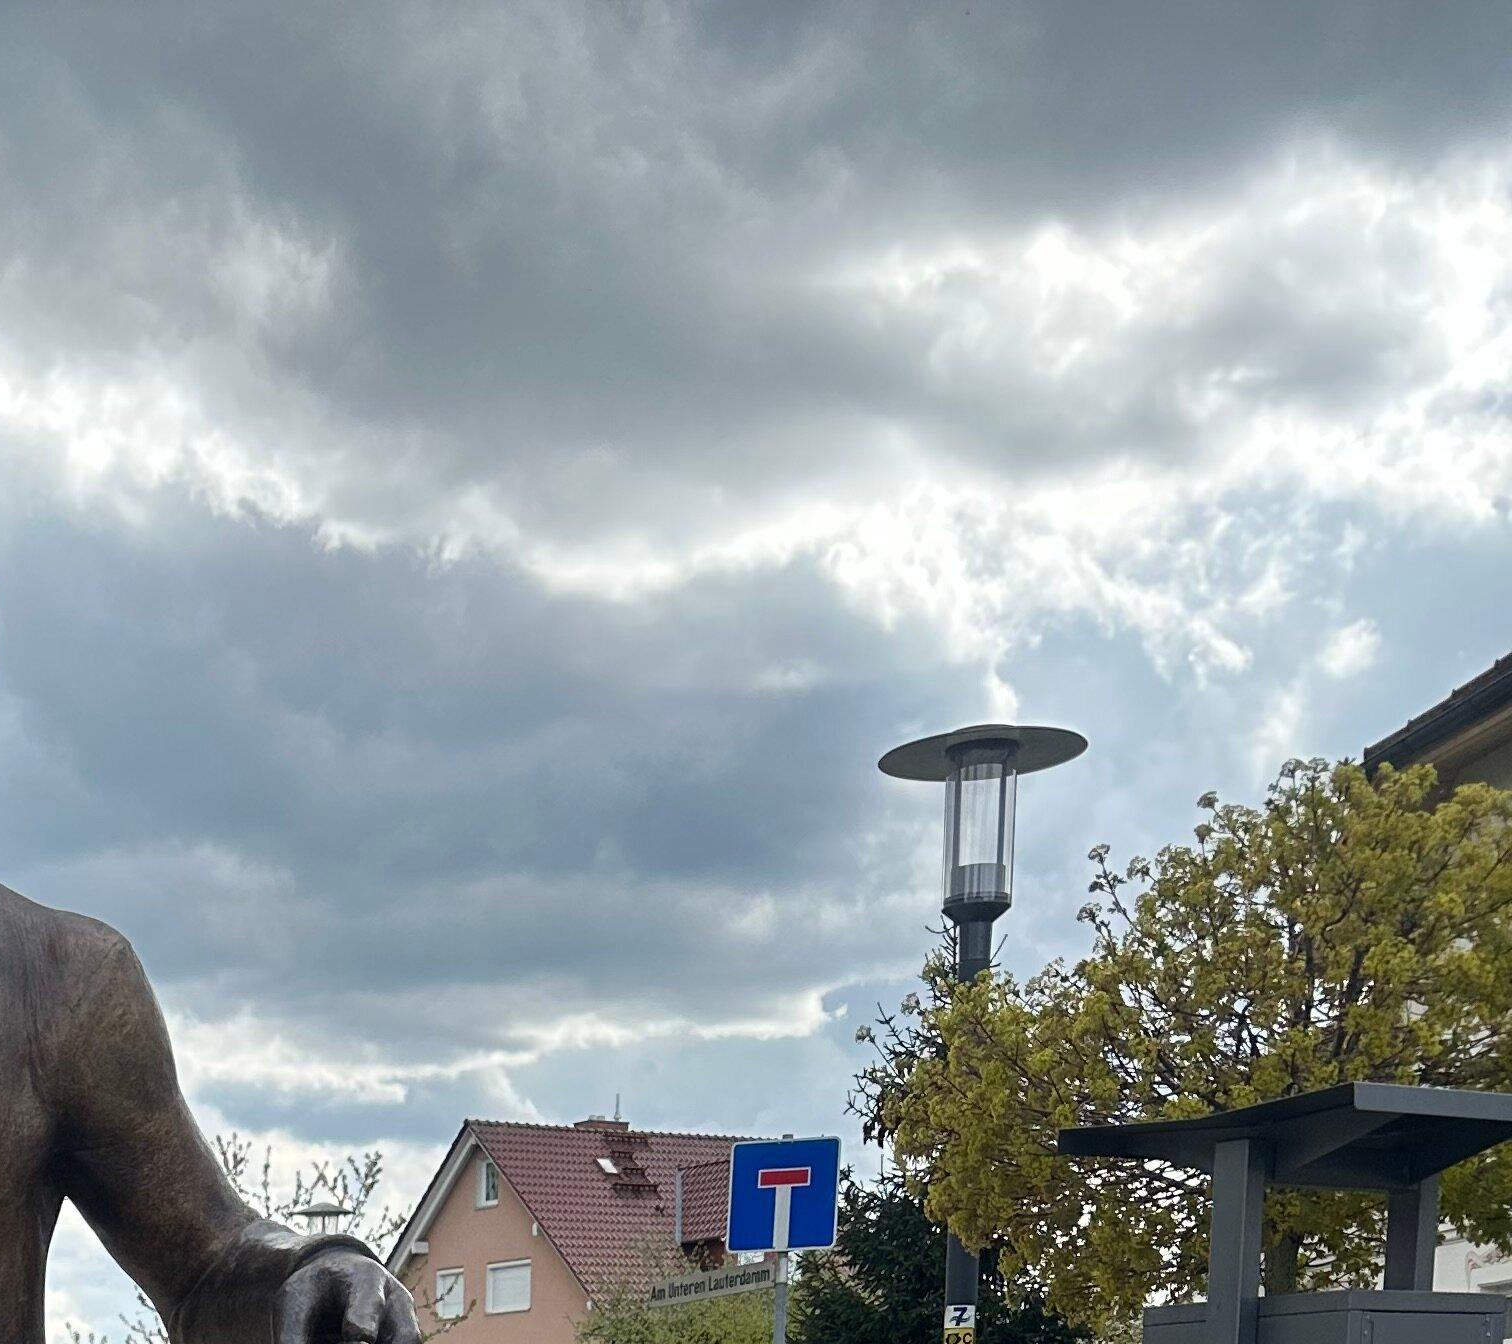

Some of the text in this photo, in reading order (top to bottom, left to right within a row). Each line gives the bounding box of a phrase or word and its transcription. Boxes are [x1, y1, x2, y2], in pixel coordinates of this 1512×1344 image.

[650, 1268, 771, 1301] Am Unteren Lauterdamm
